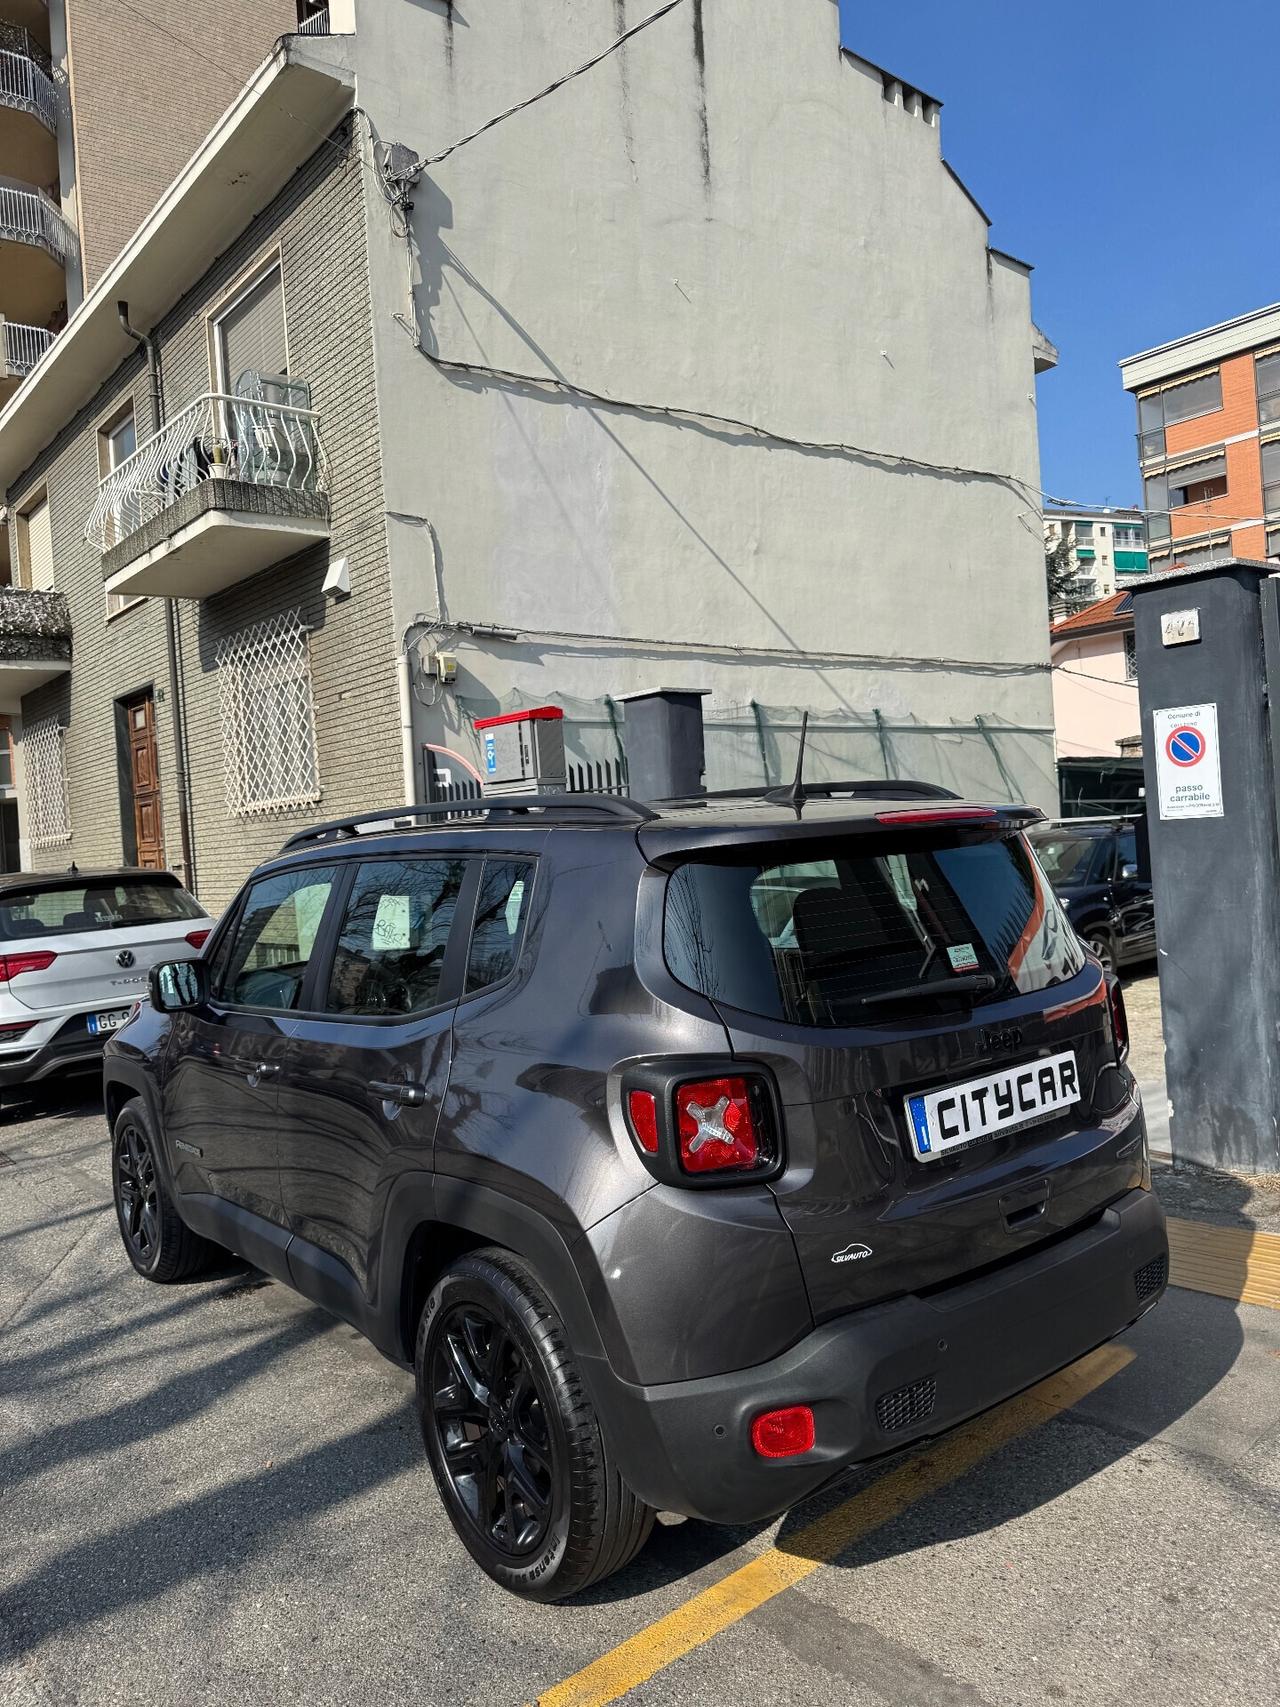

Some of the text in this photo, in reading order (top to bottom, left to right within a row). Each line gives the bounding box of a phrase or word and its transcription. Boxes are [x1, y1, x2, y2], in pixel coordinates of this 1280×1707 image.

[1167, 712, 1194, 720] Comune
[1175, 784, 1203, 794] passo
[1169, 792, 1211, 802] carrabile
[98, 1013, 117, 1029] GG
[975, 1026, 1022, 1048] Jeep
[937, 1060, 1078, 1140] CITYCAR
[832, 1250, 868, 1263] SILVAUTO
